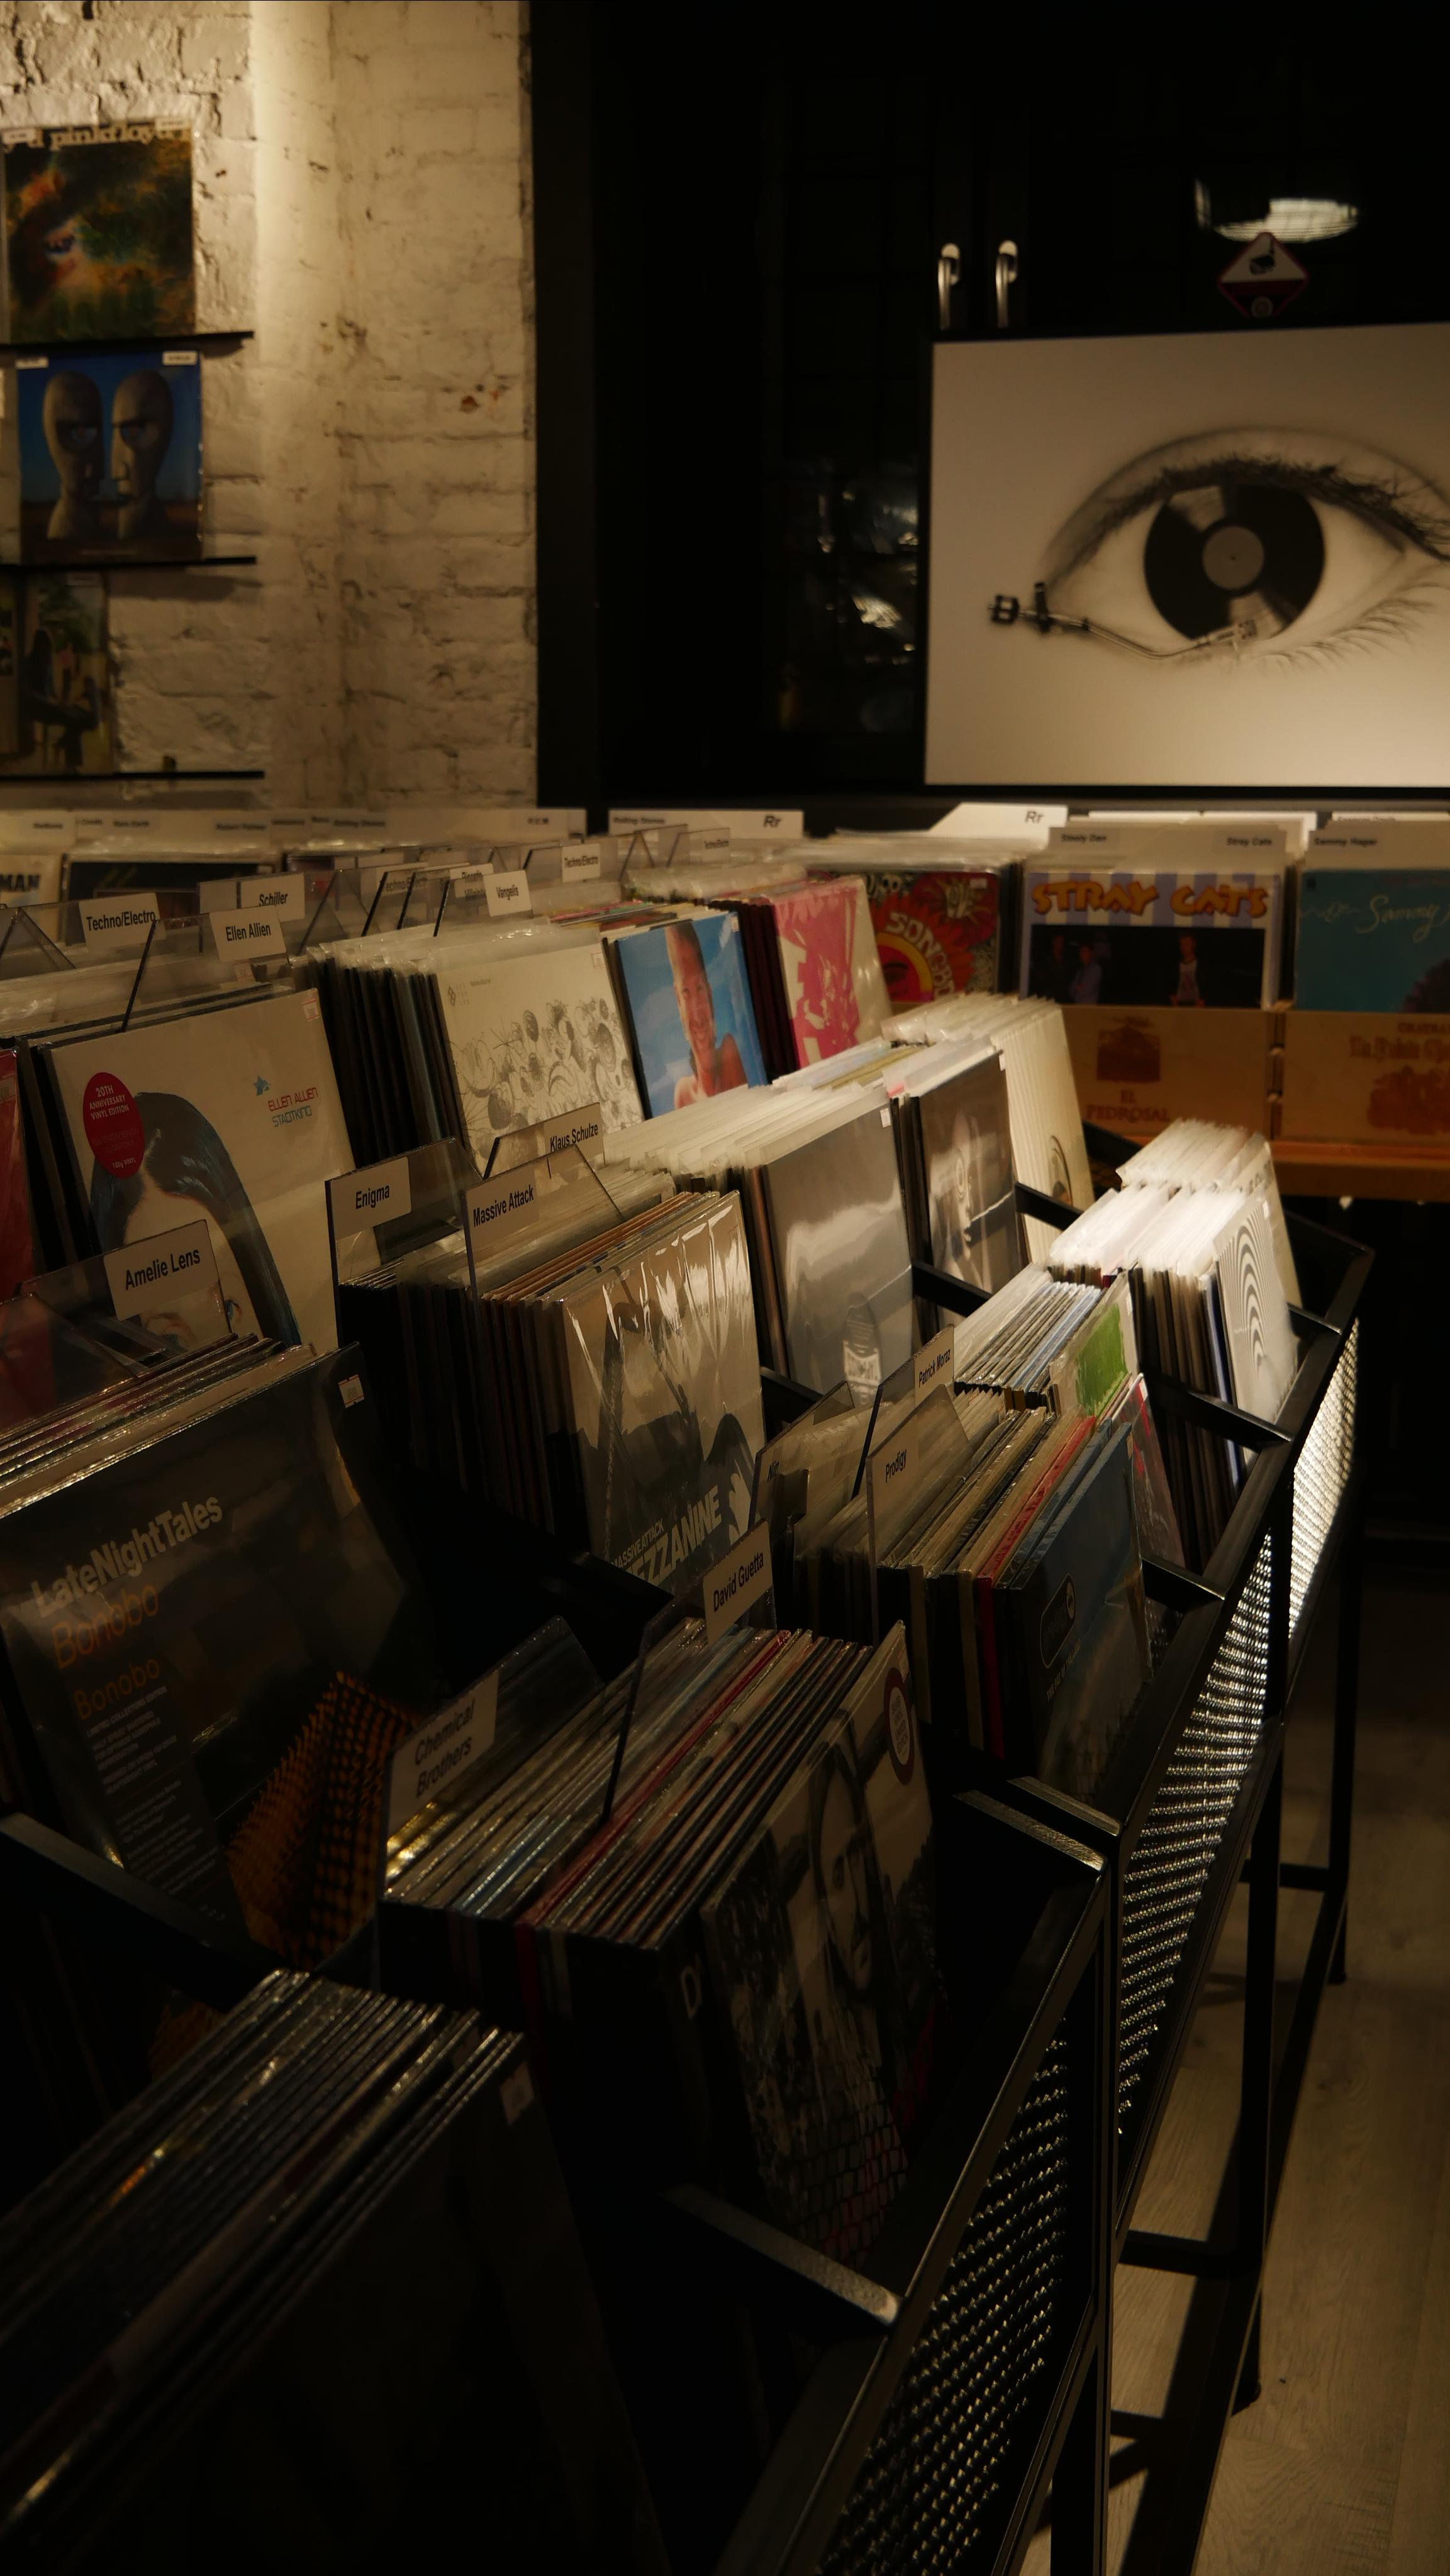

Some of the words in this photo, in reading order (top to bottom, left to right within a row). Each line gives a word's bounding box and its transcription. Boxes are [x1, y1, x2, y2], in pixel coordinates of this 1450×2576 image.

[259, 892, 288, 906] Schiller
[496, 886, 519, 901] Vangelis
[1031, 880, 1158, 916] STRAY
[1169, 884, 1269, 918] CATS
[86, 909, 156, 931] Techno/Electro
[225, 926, 247, 941] Ellen
[248, 922, 271, 937] Allien
[89, 1094, 126, 1111] ANNIVERSARY
[95, 1085, 114, 1097] 20TH
[268, 1095, 293, 1112] ELLEN
[91, 1110, 109, 1121] VINYL
[109, 1104, 130, 1116] EDITION
[549, 1135, 571, 1152] Klaus
[571, 1123, 599, 1145] Schulze
[355, 1184, 390, 1210] Enigma
[473, 1198, 507, 1227] Massive
[508, 1185, 534, 1209] Attack
[125, 1259, 169, 1291] Amelie
[171, 1247, 201, 1273] Lens
[918, 1359, 936, 1388] Patrick
[885, 1449, 907, 1483] Prodigy
[626, 1484, 723, 1586] EZZANINE
[712, 1571, 737, 1613] David
[738, 1550, 764, 1591] Guetta
[72, 1655, 161, 1720] Bonobo
[415, 1696, 476, 1765] Chemical
[416, 1736, 472, 1797] Brothers
